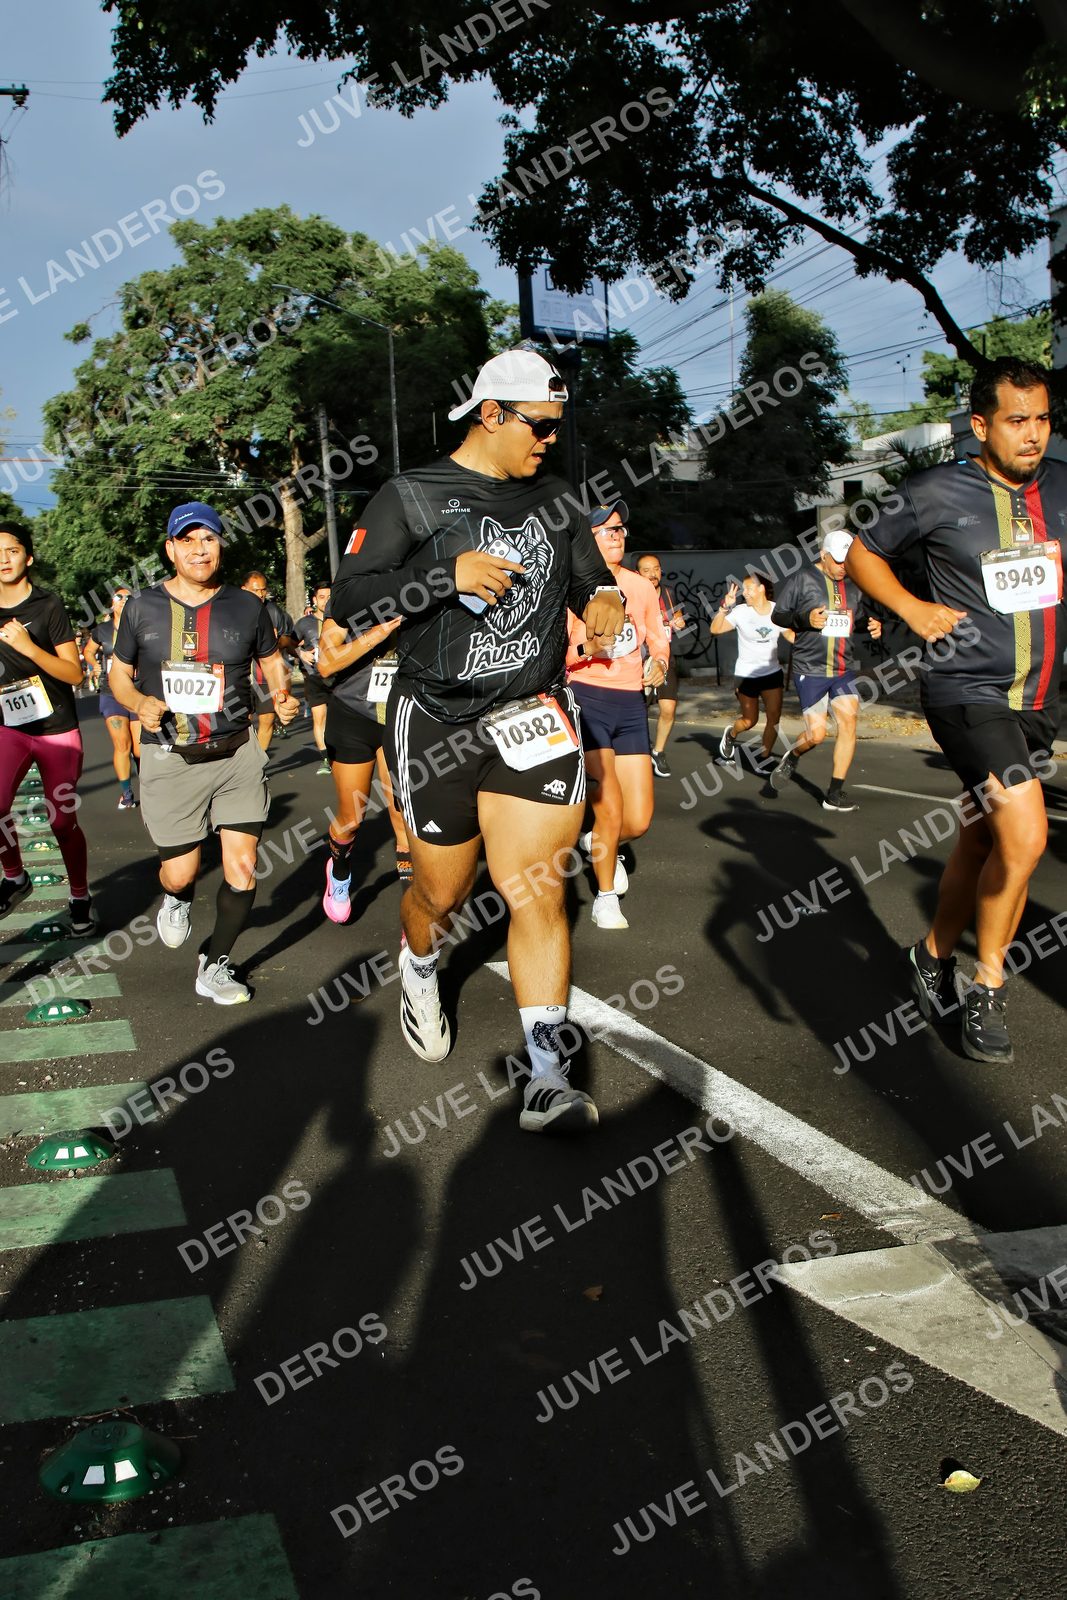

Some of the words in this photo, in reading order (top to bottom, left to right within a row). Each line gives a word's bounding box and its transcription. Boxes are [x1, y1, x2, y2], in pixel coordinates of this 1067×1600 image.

[441, 507, 471, 515] TOPTIME
[994, 565, 1046, 591] 8949
[470, 631, 497, 649] LA
[164, 677, 217, 697] 10027
[5, 692, 36, 712] 1611
[496, 713, 561, 749] 10382
